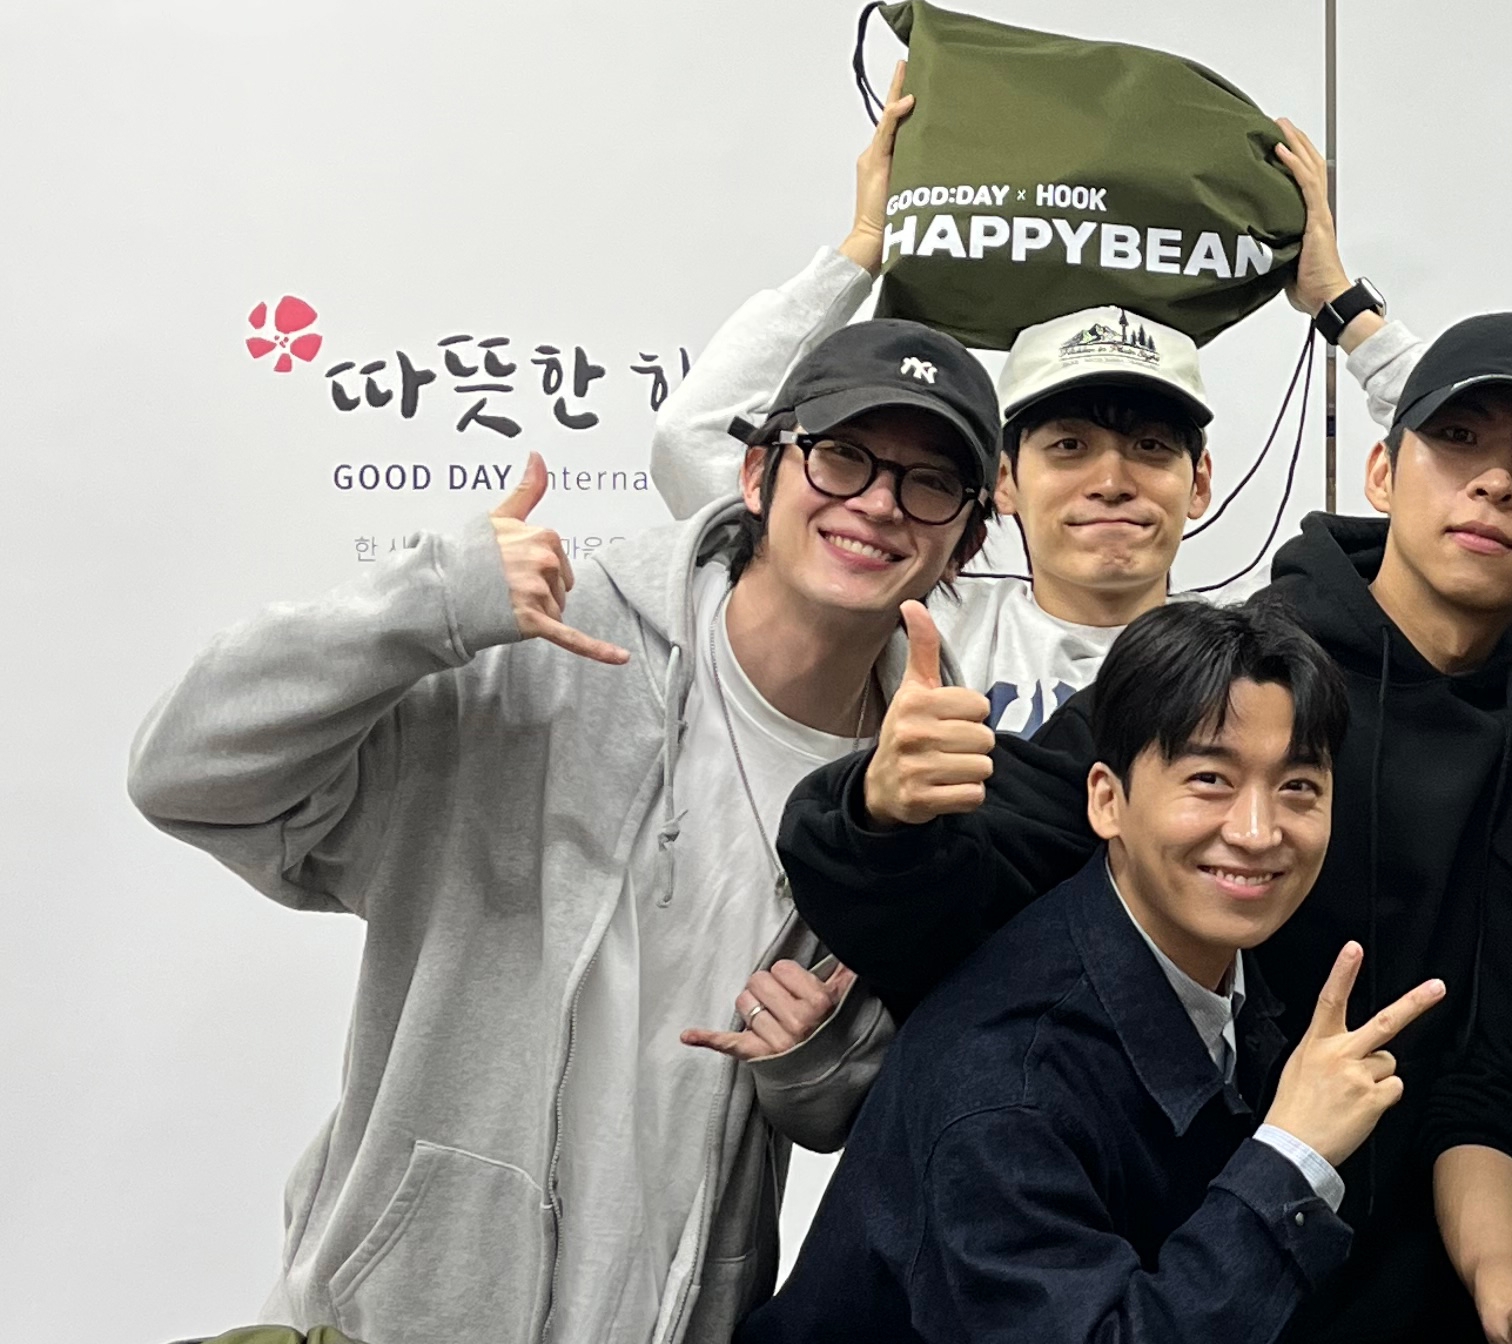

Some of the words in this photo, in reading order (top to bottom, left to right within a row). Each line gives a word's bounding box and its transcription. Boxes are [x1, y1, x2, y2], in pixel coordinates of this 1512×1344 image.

[1036, 184, 1108, 212] HOOK
[882, 214, 1273, 278] HAPPYBEAN
[325, 334, 605, 438] 따뜻한
[333, 464, 431, 491] GOOD
[449, 464, 512, 491] DAY
